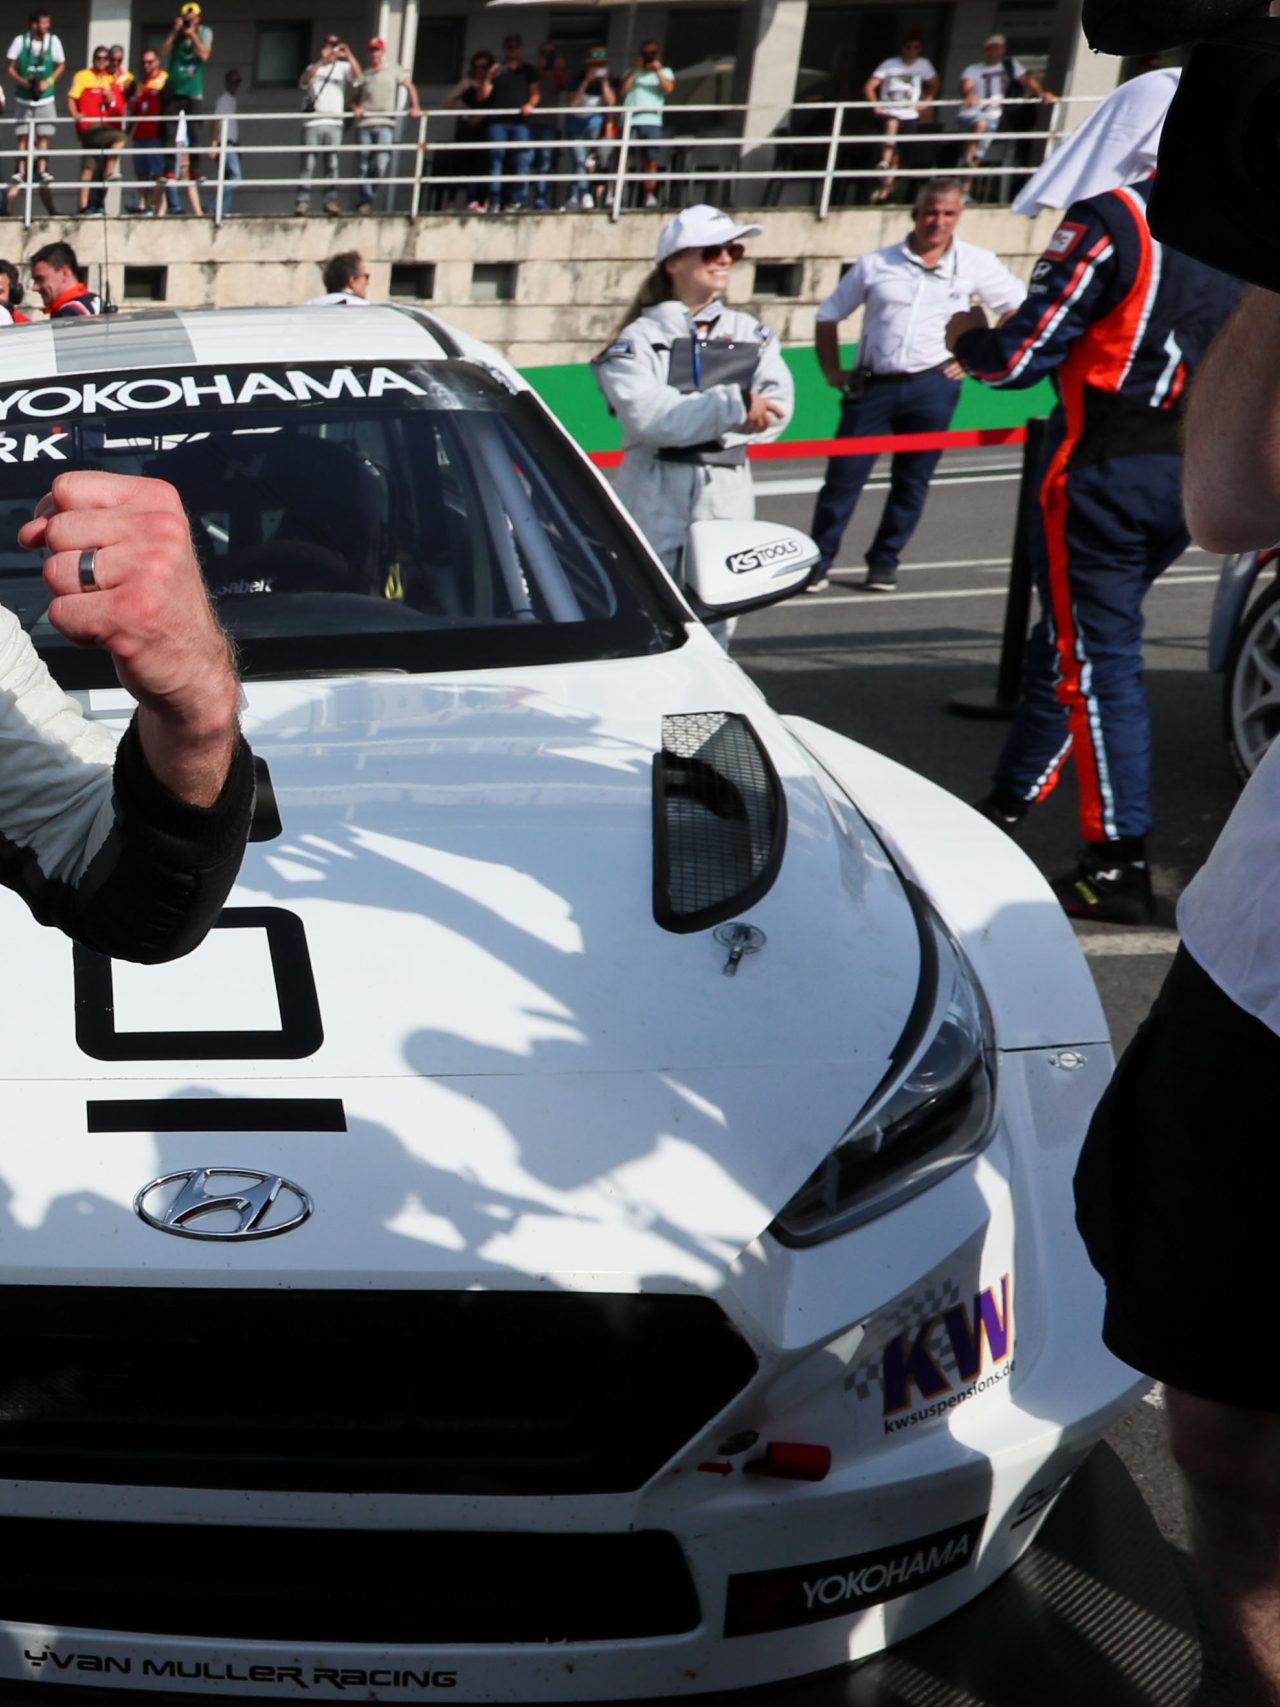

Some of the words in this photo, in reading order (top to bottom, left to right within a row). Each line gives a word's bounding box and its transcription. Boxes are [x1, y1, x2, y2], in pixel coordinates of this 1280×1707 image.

[883, 1272, 1010, 1417] KW
[884, 1359, 1016, 1434] kwsuspensions.de
[802, 1533, 968, 1608] YOKOHAMA
